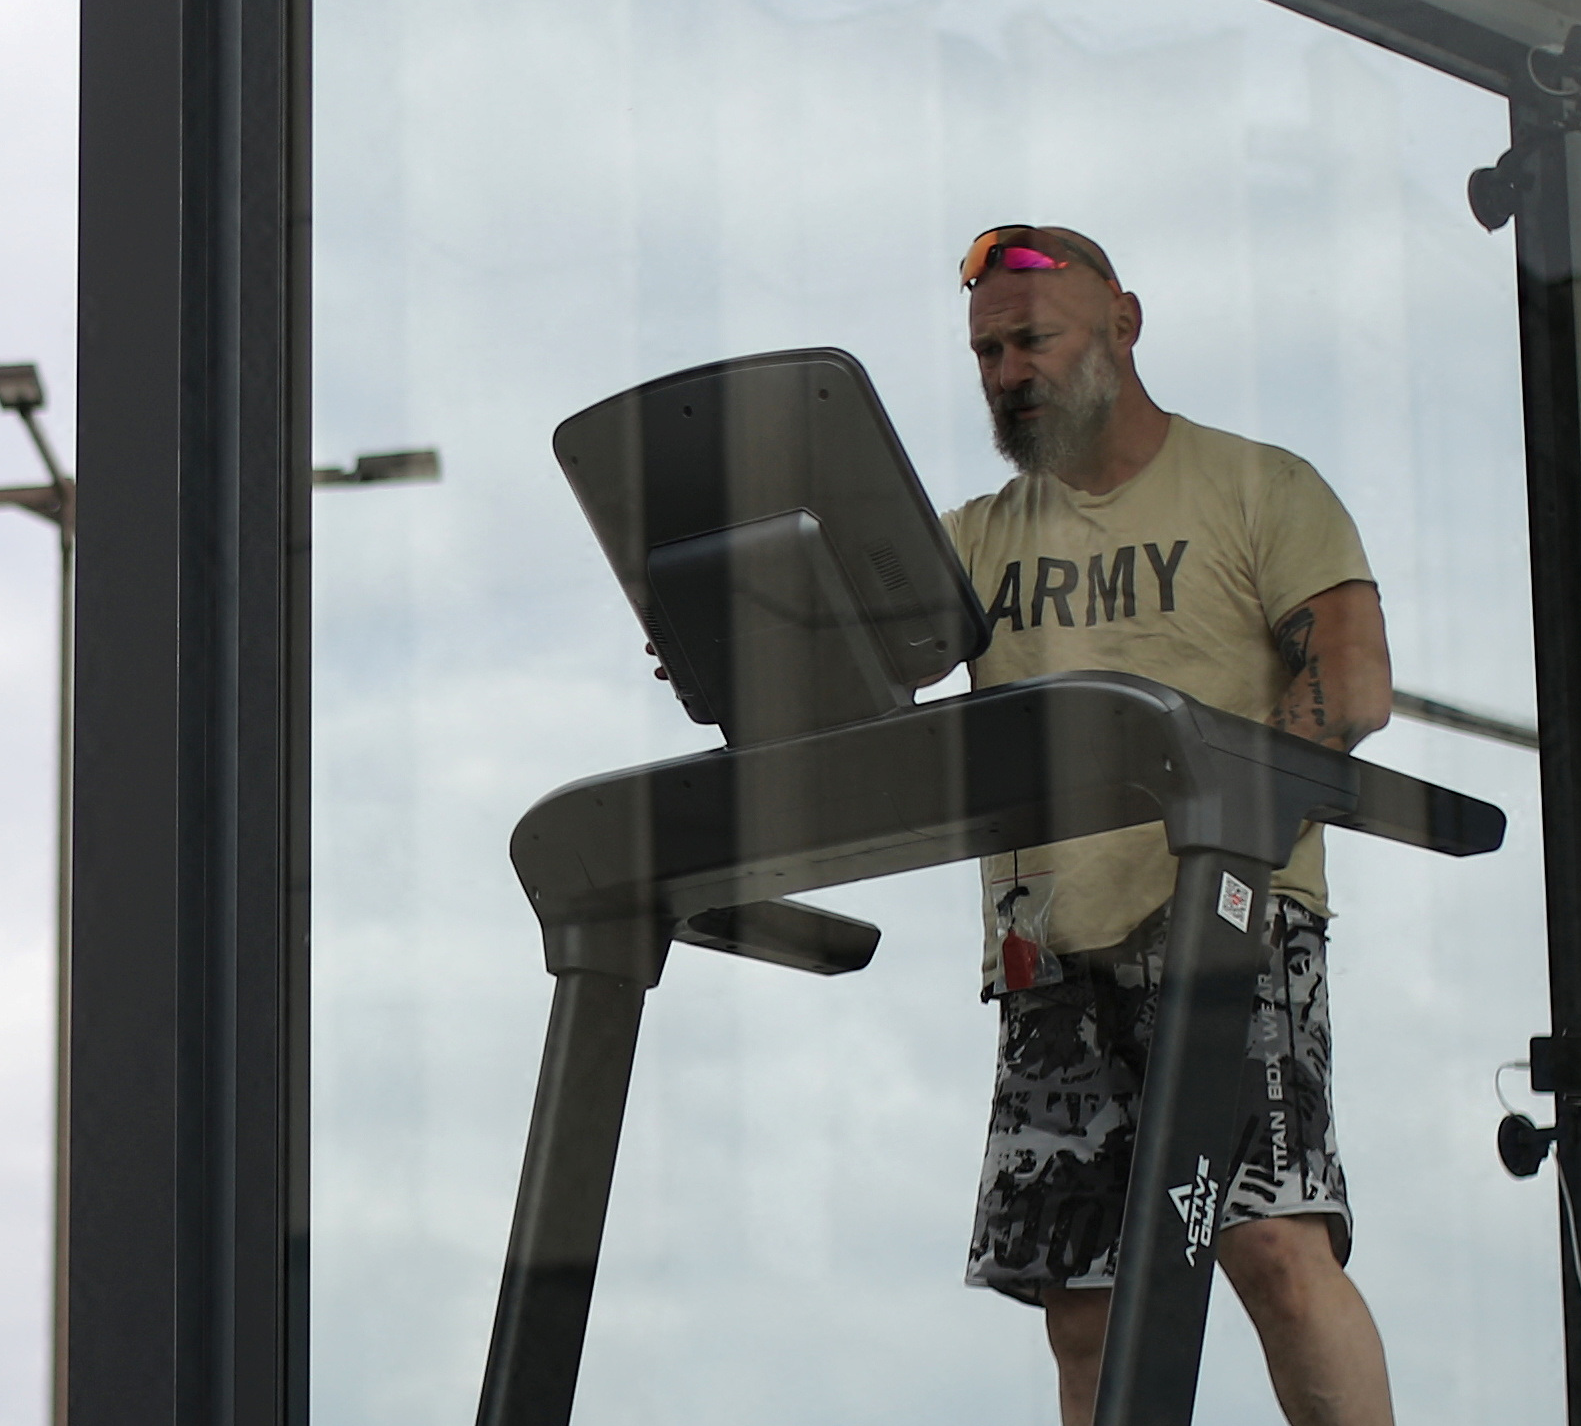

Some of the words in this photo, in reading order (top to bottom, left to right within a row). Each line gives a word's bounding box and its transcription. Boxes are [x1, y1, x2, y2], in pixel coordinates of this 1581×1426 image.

[987, 539, 1189, 632] ARMY
[1256, 973, 1278, 1042] WEAR
[1265, 1052, 1284, 1101] BOX
[1269, 1110, 1288, 1182] TITAN
